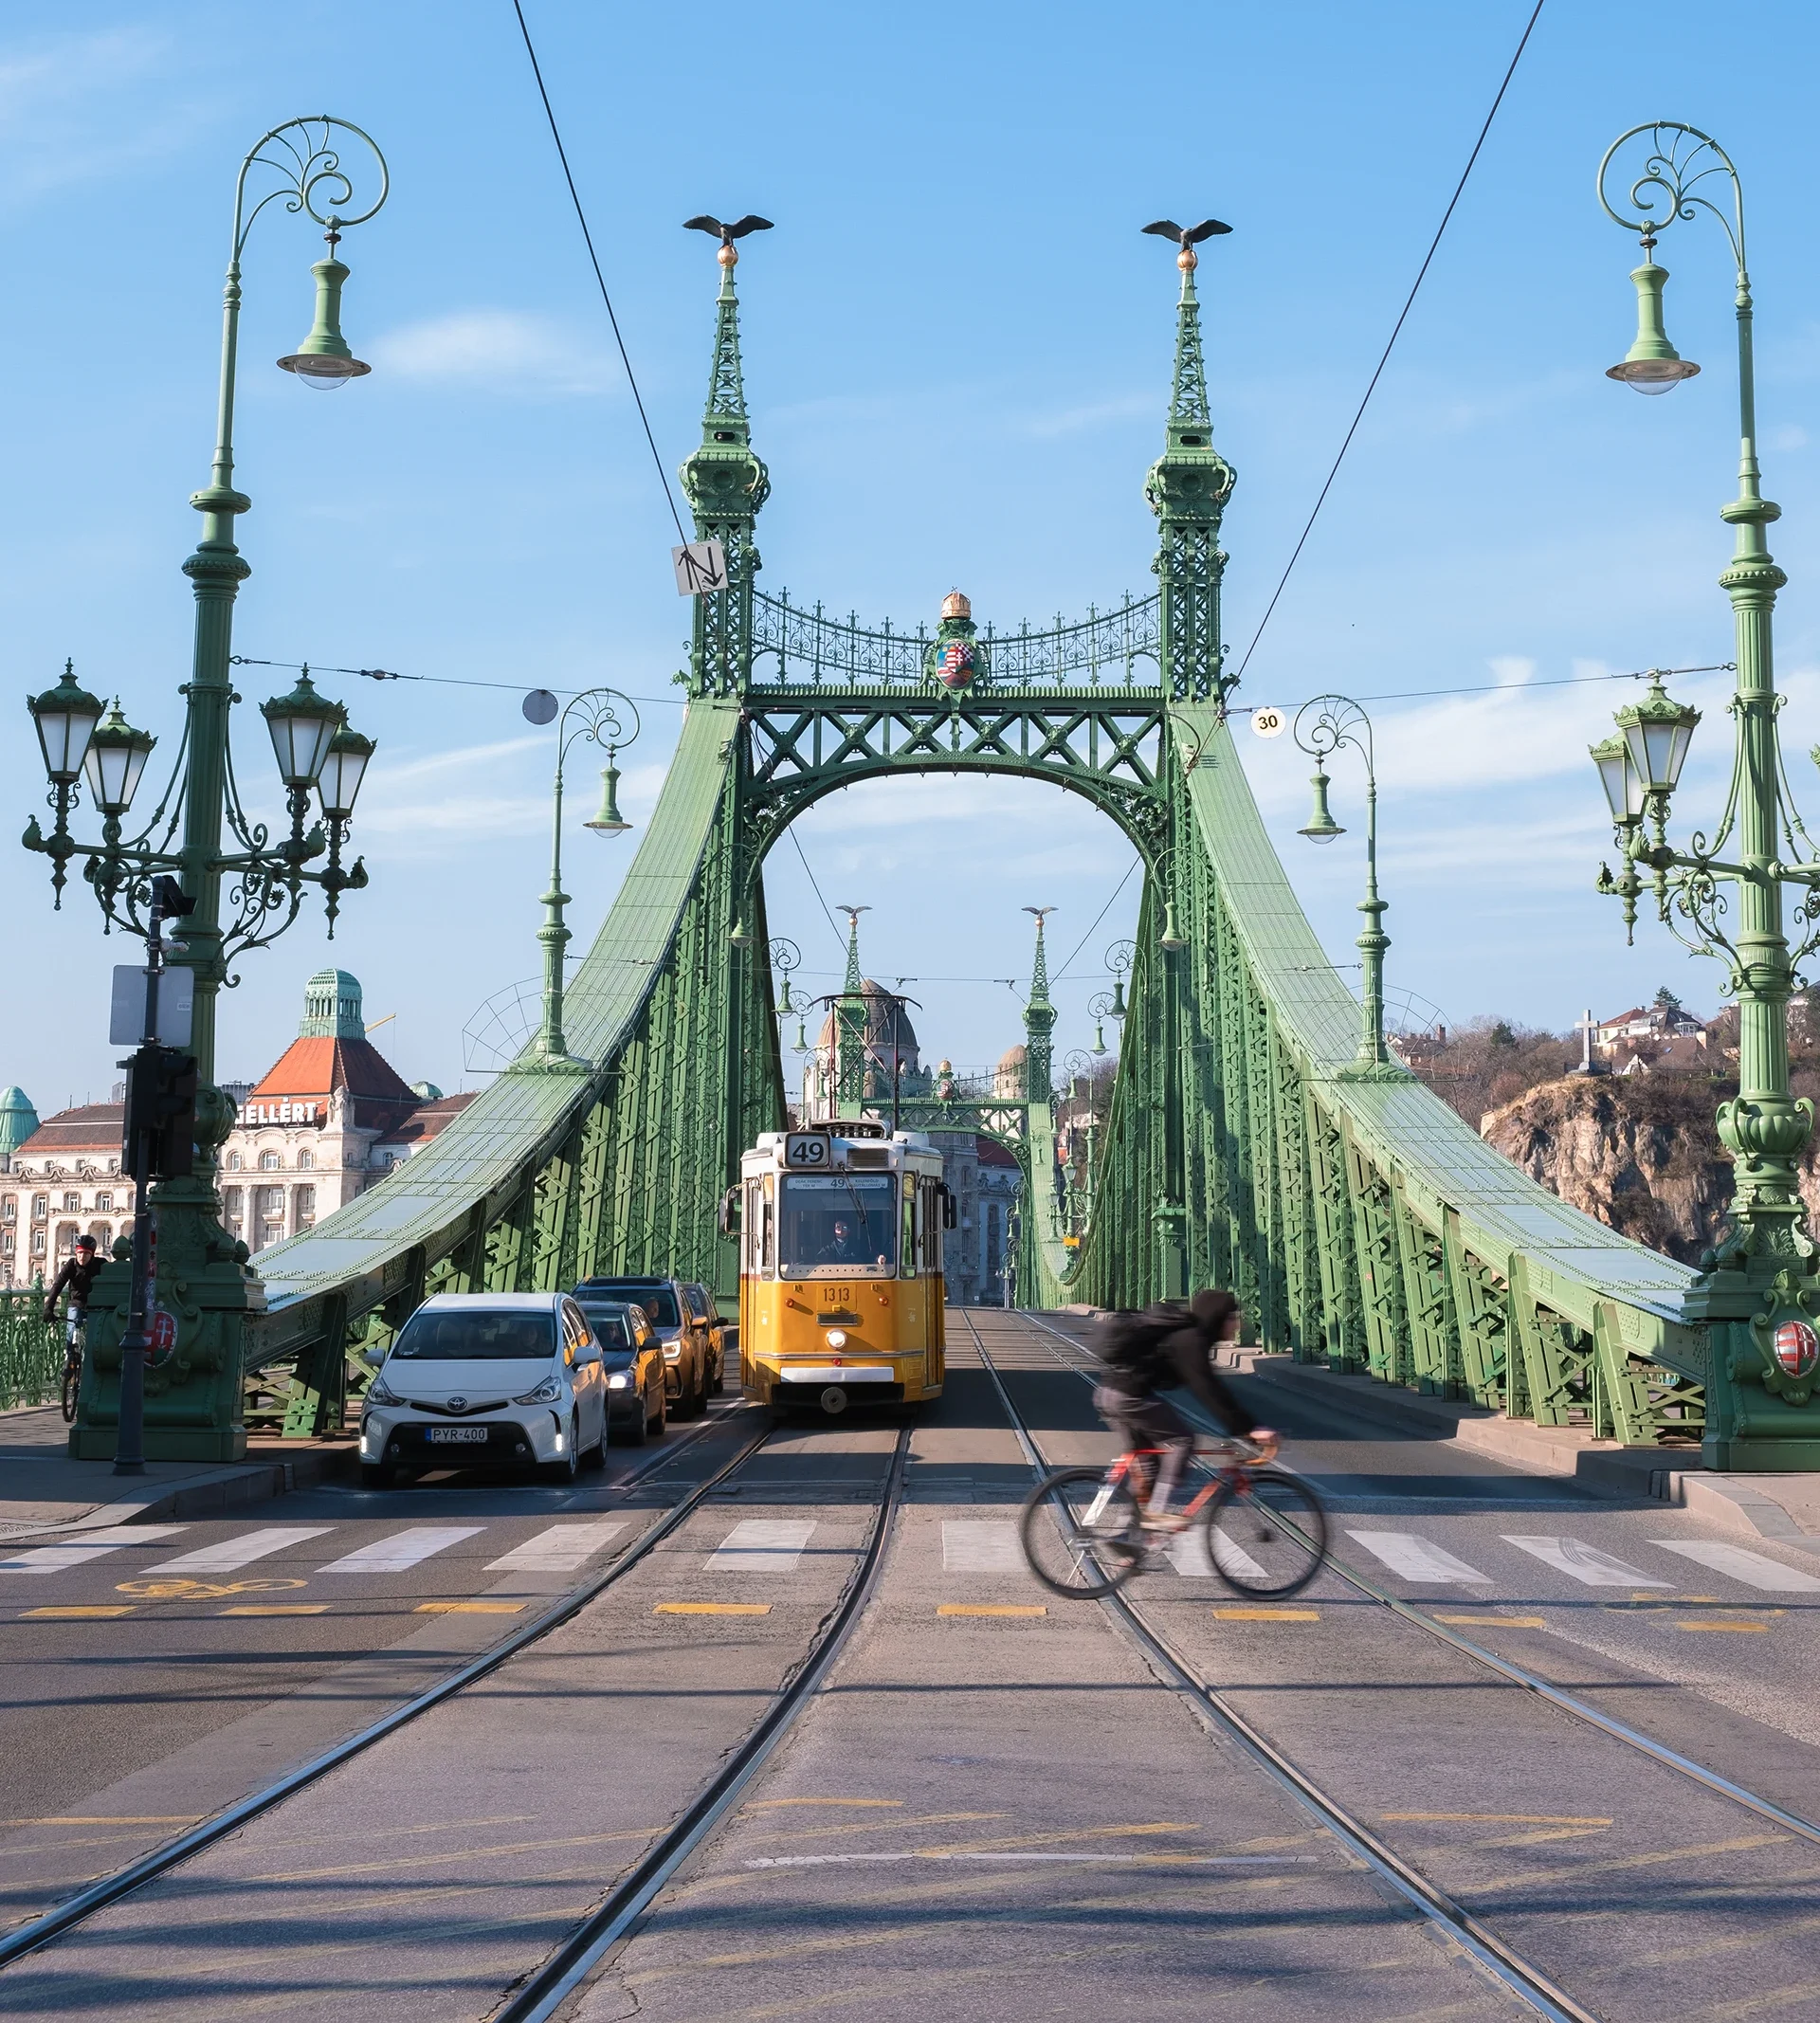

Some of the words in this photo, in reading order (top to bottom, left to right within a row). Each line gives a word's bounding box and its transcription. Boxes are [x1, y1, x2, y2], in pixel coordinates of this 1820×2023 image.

[1258, 714, 1278, 730] 30
[792, 1141, 825, 1163] 49
[830, 1178, 845, 1188] 49
[823, 1287, 850, 1302] 1313
[433, 1429, 485, 1440] PYR-400
